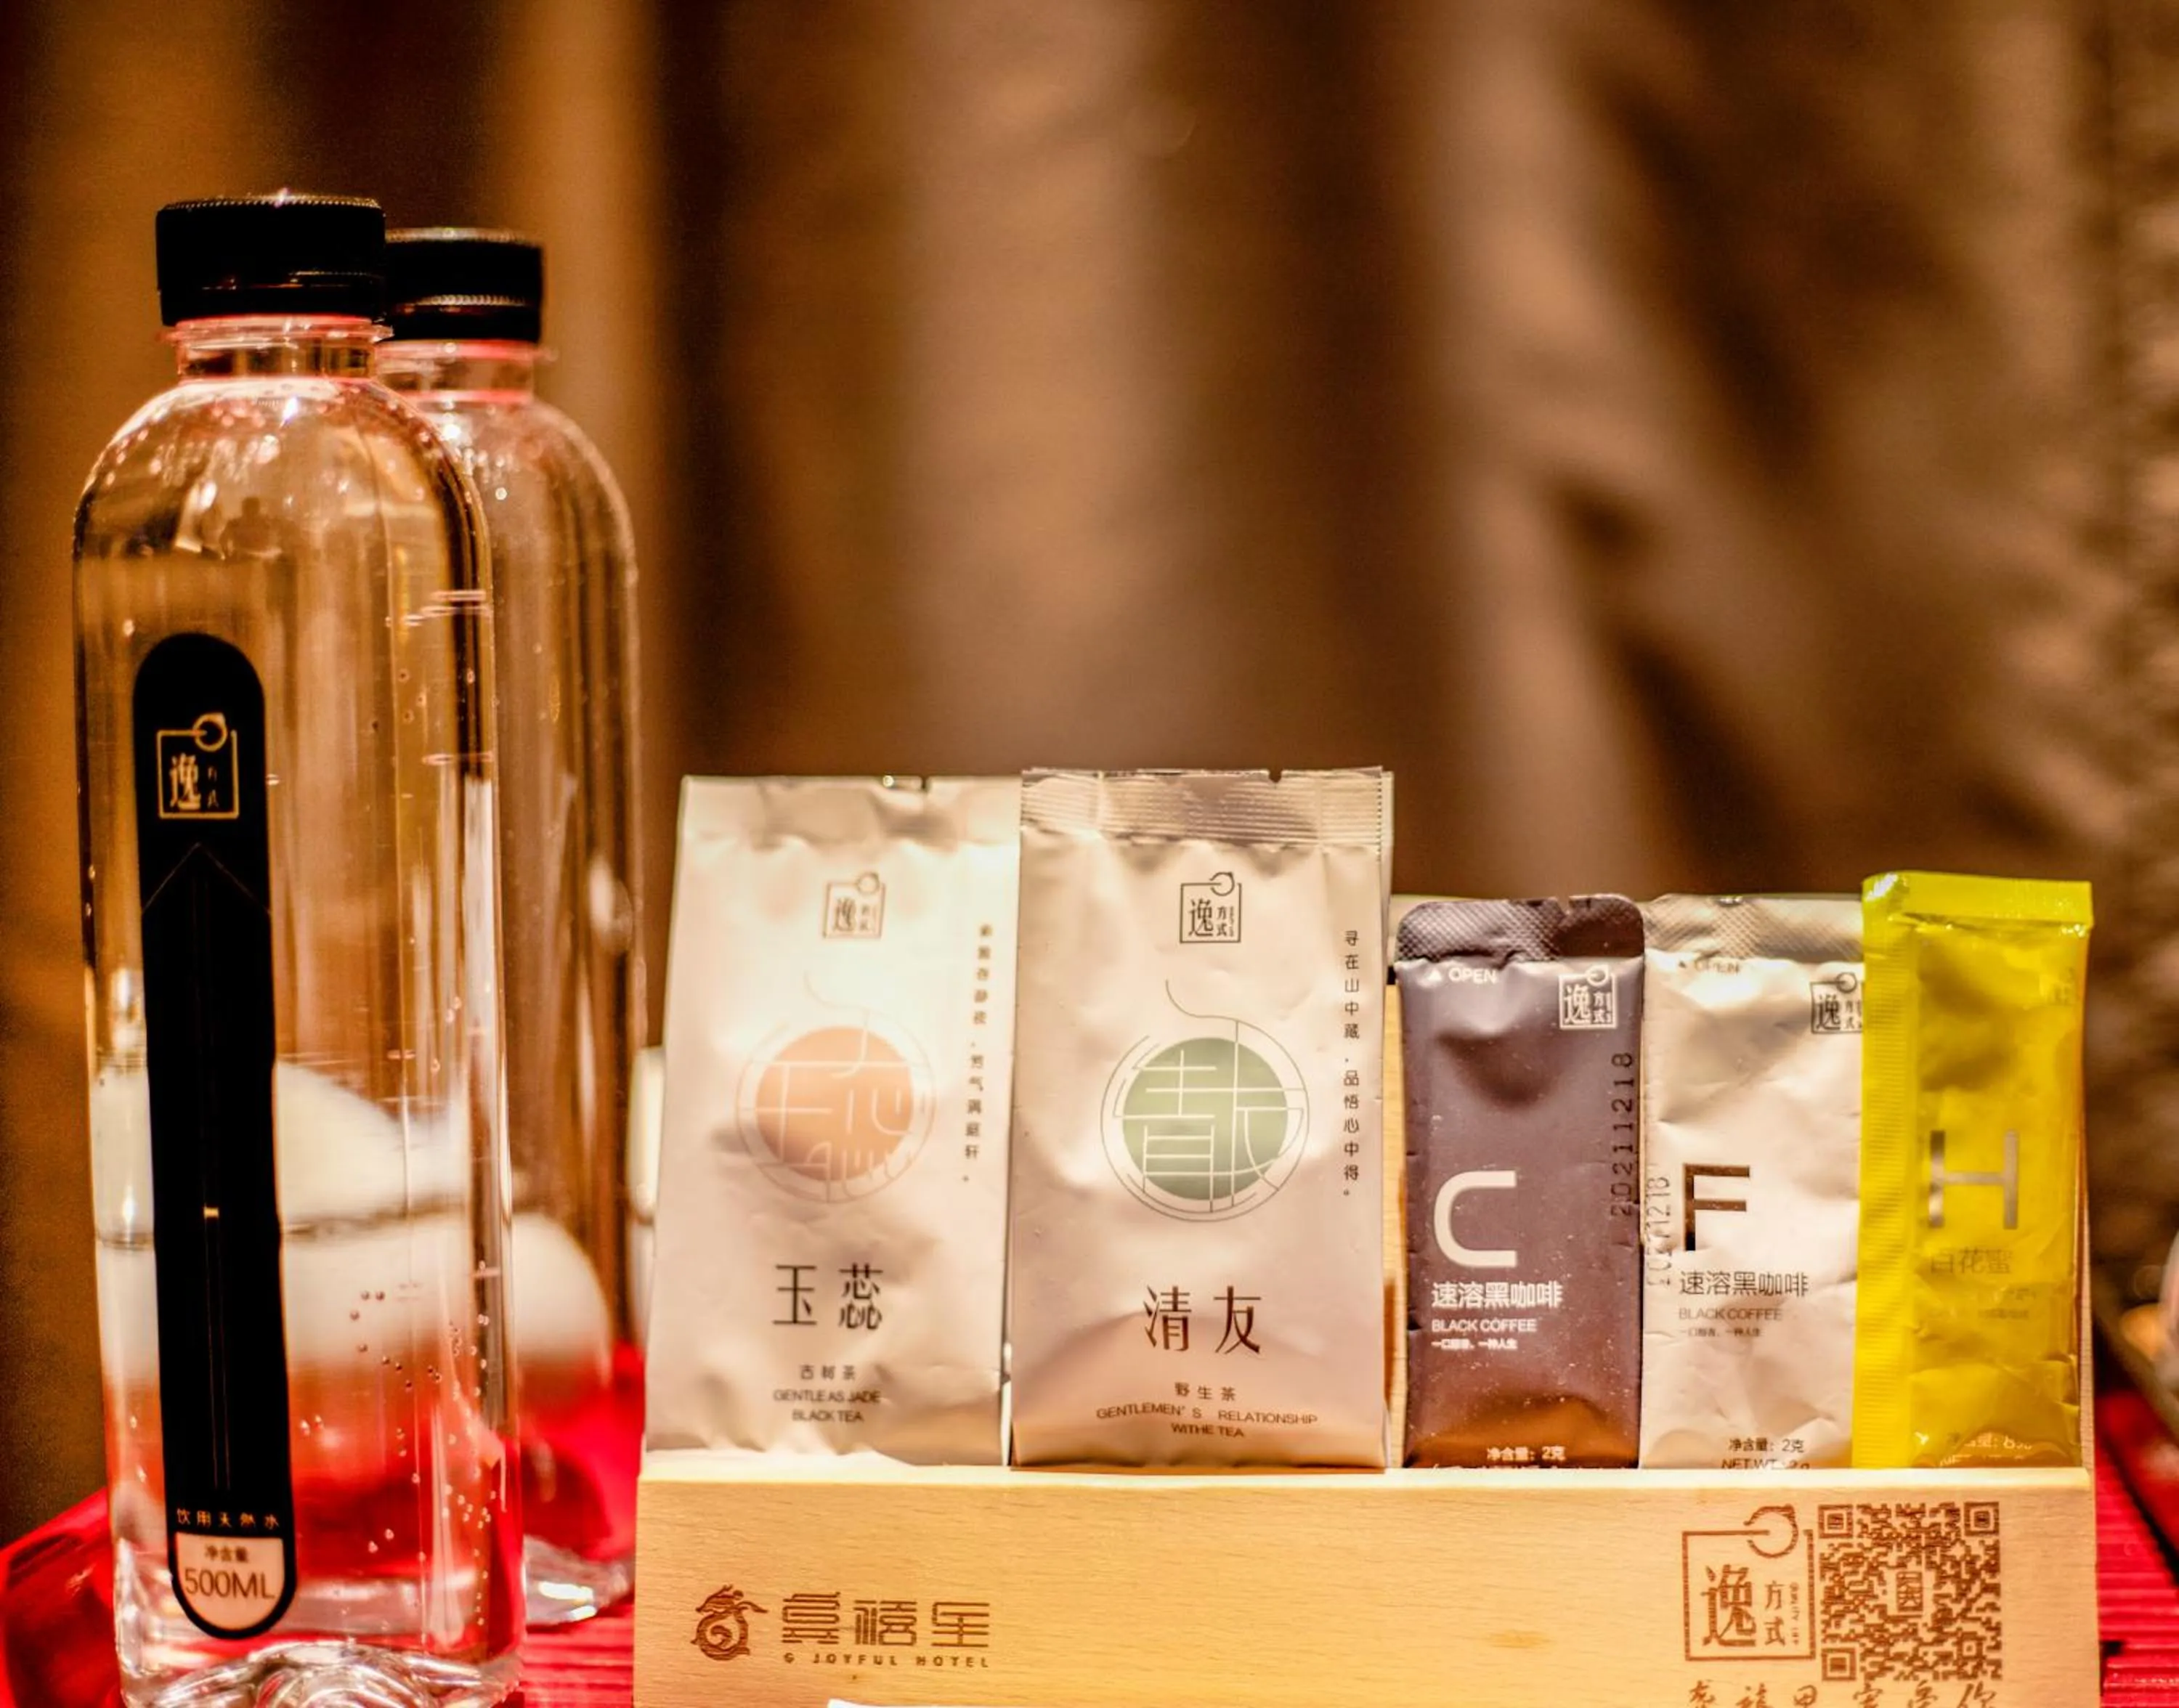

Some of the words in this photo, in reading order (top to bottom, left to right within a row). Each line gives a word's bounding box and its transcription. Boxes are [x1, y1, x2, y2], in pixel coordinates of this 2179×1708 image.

[1449, 968, 1498, 984] OPEN
[1928, 1129, 2018, 1229] H
[1683, 1163, 1750, 1251] F
[1434, 1171, 1517, 1267] C
[1679, 1271, 1809, 1297] 速溶黑咖啡
[772, 1263, 883, 1330] 玉蕊
[1431, 1281, 1563, 1308] 速溶黑咖啡
[1143, 1285, 1262, 1354] 清友
[1679, 1308, 1726, 1320] BLACK
[1727, 1308, 1782, 1320] COFFEE
[1432, 1319, 1477, 1332] BLACK
[1480, 1319, 1537, 1332] COFFEE
[800, 1365, 856, 1380] 古树茶
[773, 1390, 827, 1402] GENTLE
[828, 1391, 845, 1403] AS
[848, 1390, 882, 1404] JADE
[1174, 1382, 1237, 1402] 野生茶
[792, 1410, 836, 1422] BLACK
[838, 1410, 865, 1423] TEA
[1218, 1410, 1318, 1426] RELATIONSHIP
[1171, 1422, 1214, 1436] WITHE
[1219, 1425, 1245, 1438] TEA
[184, 1568, 275, 1599] 500ML
[1700, 1564, 1757, 1648] 逸
[812, 1653, 898, 1666] JOYFUL
[915, 1656, 989, 1668] HOTEL
